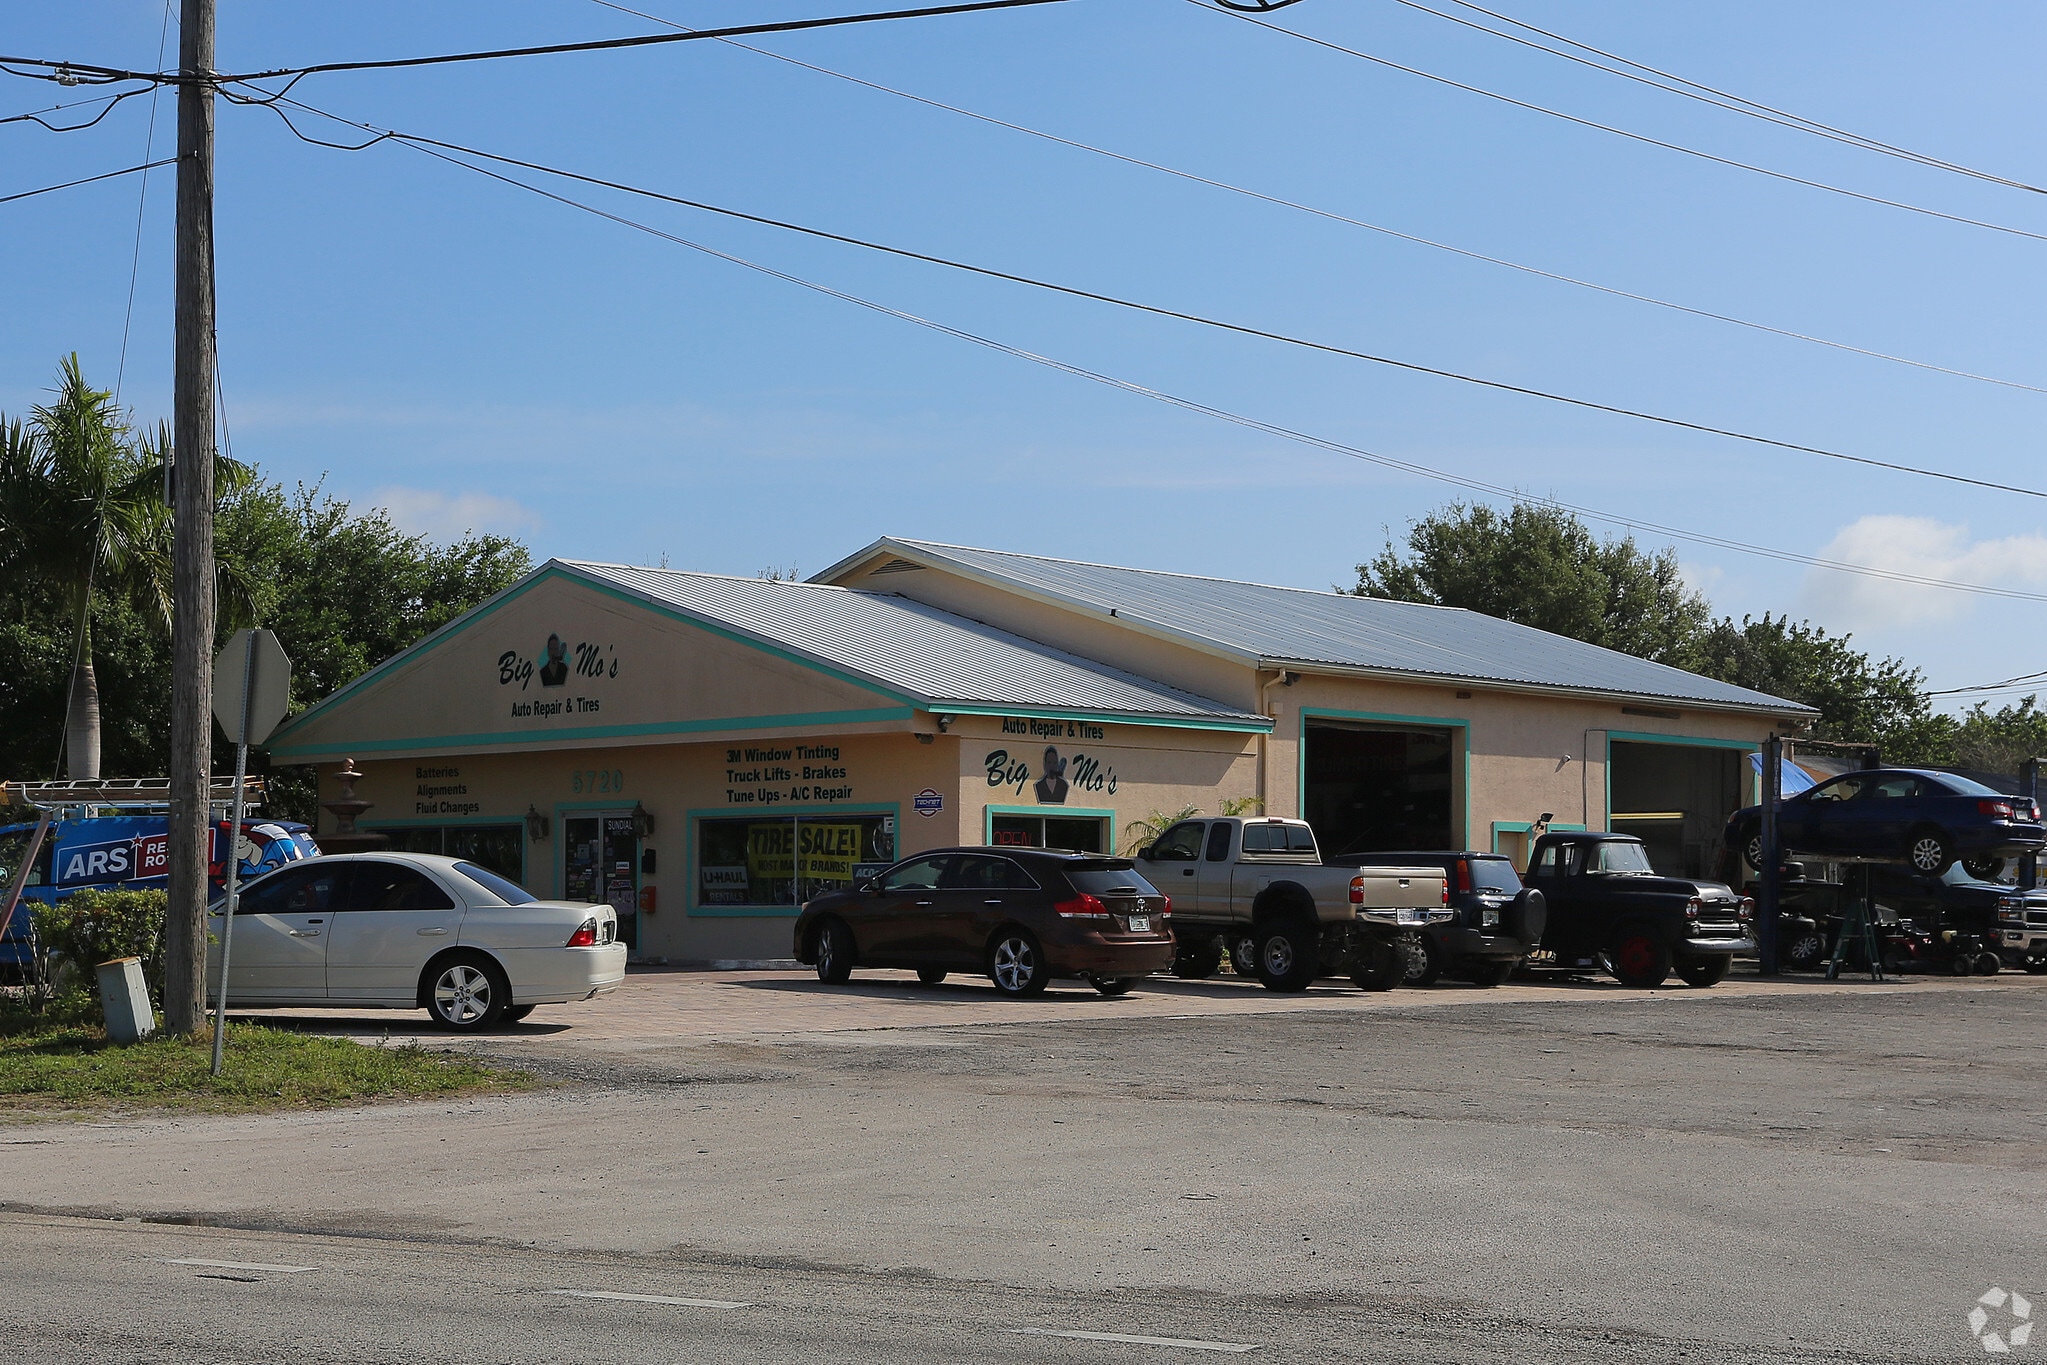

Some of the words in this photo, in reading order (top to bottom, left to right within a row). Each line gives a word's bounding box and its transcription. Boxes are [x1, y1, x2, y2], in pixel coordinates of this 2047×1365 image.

[498, 650, 534, 691] Big
[576, 642, 618, 679] Mo's
[511, 702, 532, 717] Auto
[534, 699, 562, 719] Repair
[566, 698, 573, 713] &
[577, 697, 600, 713] Tires
[1002, 717, 1026, 734] Auto
[1030, 719, 1063, 739] Repair
[1067, 721, 1075, 737] &
[1078, 721, 1104, 739] Tires
[727, 749, 741, 763] 3M
[745, 748, 792, 762] Window
[796, 745, 839, 761] Tinting
[416, 767, 459, 779] Batteries
[727, 769, 760, 783] Truck
[764, 767, 791, 781] Lifts
[803, 766, 846, 780] Brakes
[985, 749, 1030, 796] Big
[1073, 754, 1117, 795] Mo's
[572, 770, 623, 793] 5720
[417, 784, 467, 798] Alignments
[727, 789, 754, 803] Tune
[758, 788, 780, 804] Ups
[790, 786, 810, 801] A/C
[814, 785, 852, 802] Repair
[416, 802, 438, 814] Fluid
[440, 801, 479, 815] Changes
[607, 820, 633, 830] SUNDIAL
[752, 827, 794, 855] TIRE
[800, 827, 856, 856] SALE!
[993, 831, 1032, 845] OPEN
[147, 841, 168, 855] RE
[64, 847, 128, 880] ARS
[145, 854, 169, 868] RO
[780, 859, 808, 872] MAOR
[810, 859, 849, 873] BRANDS!
[709, 892, 744, 902] RENTALS
